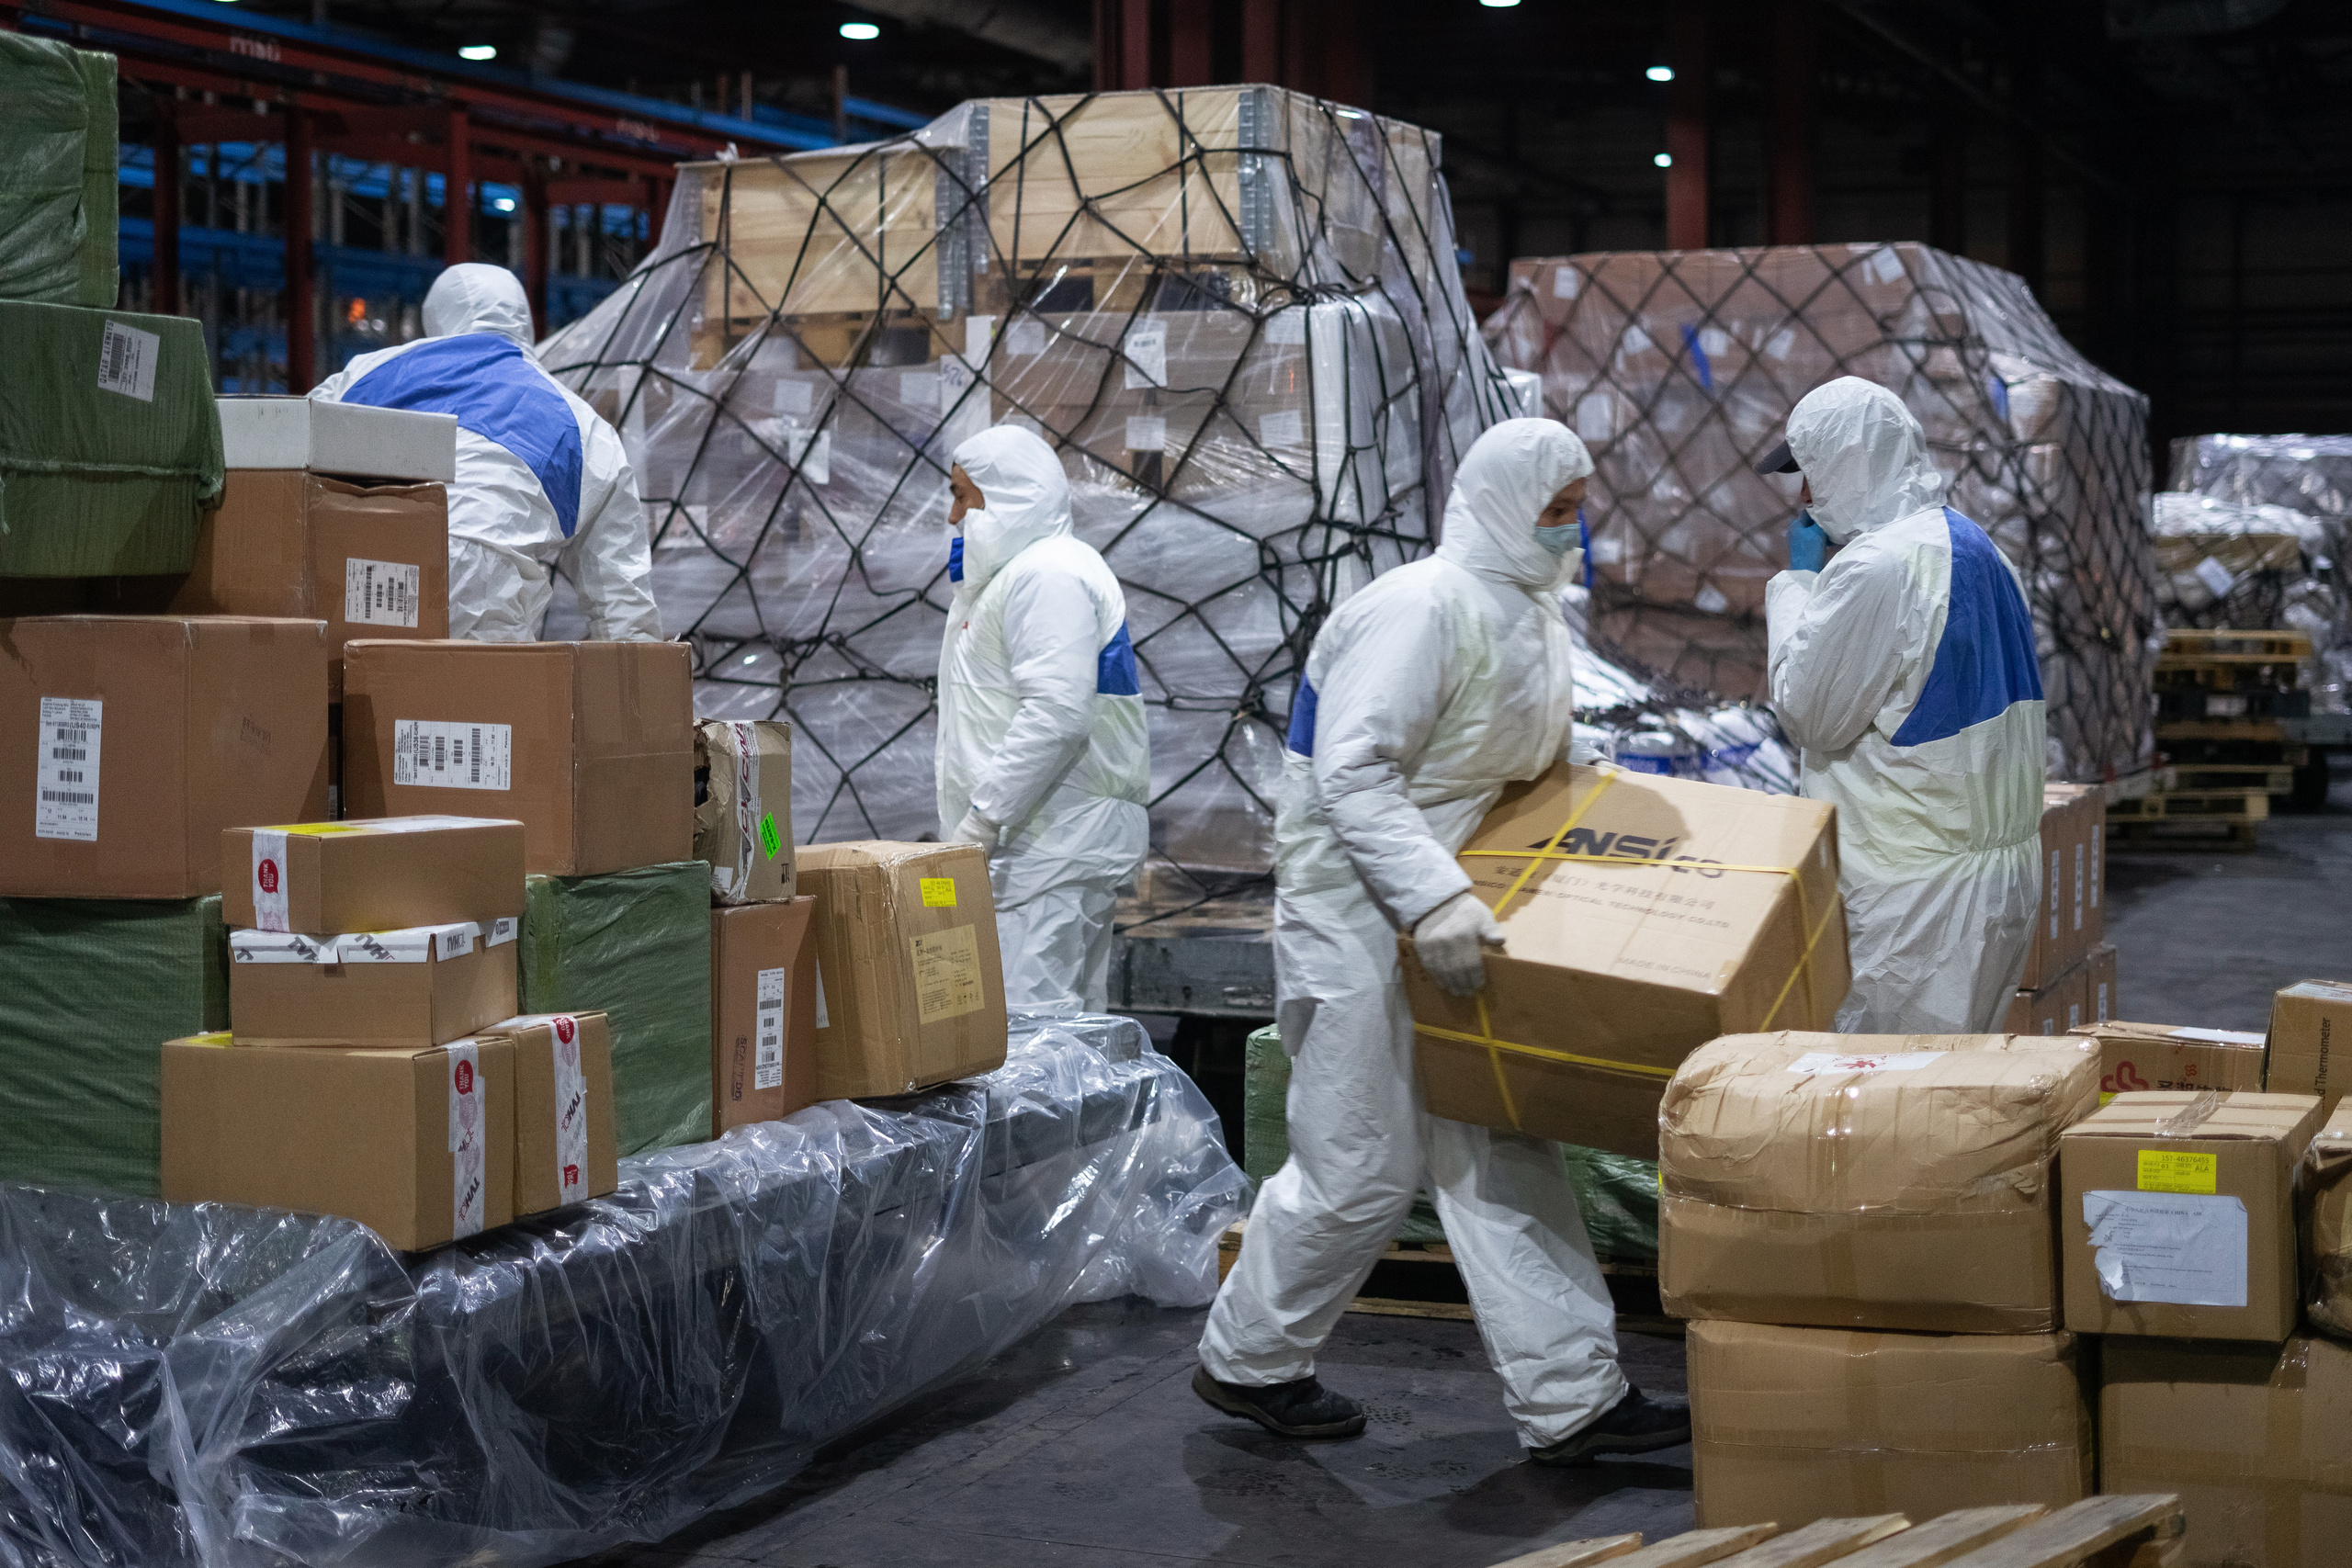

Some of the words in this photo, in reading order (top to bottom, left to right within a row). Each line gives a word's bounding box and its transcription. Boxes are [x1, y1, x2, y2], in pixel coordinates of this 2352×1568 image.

[103, 321, 114, 355] AIRWAYS
[99, 359, 109, 384] QATAR
[1557, 892, 1602, 906] OPTICAL
[1608, 900, 1686, 919] TECHNOLOGY
[1618, 956, 1655, 969] MADE
[1656, 963, 1670, 971] IN
[1670, 965, 1712, 979] CHINA
[2314, 1017, 2331, 1087] Thermometer
